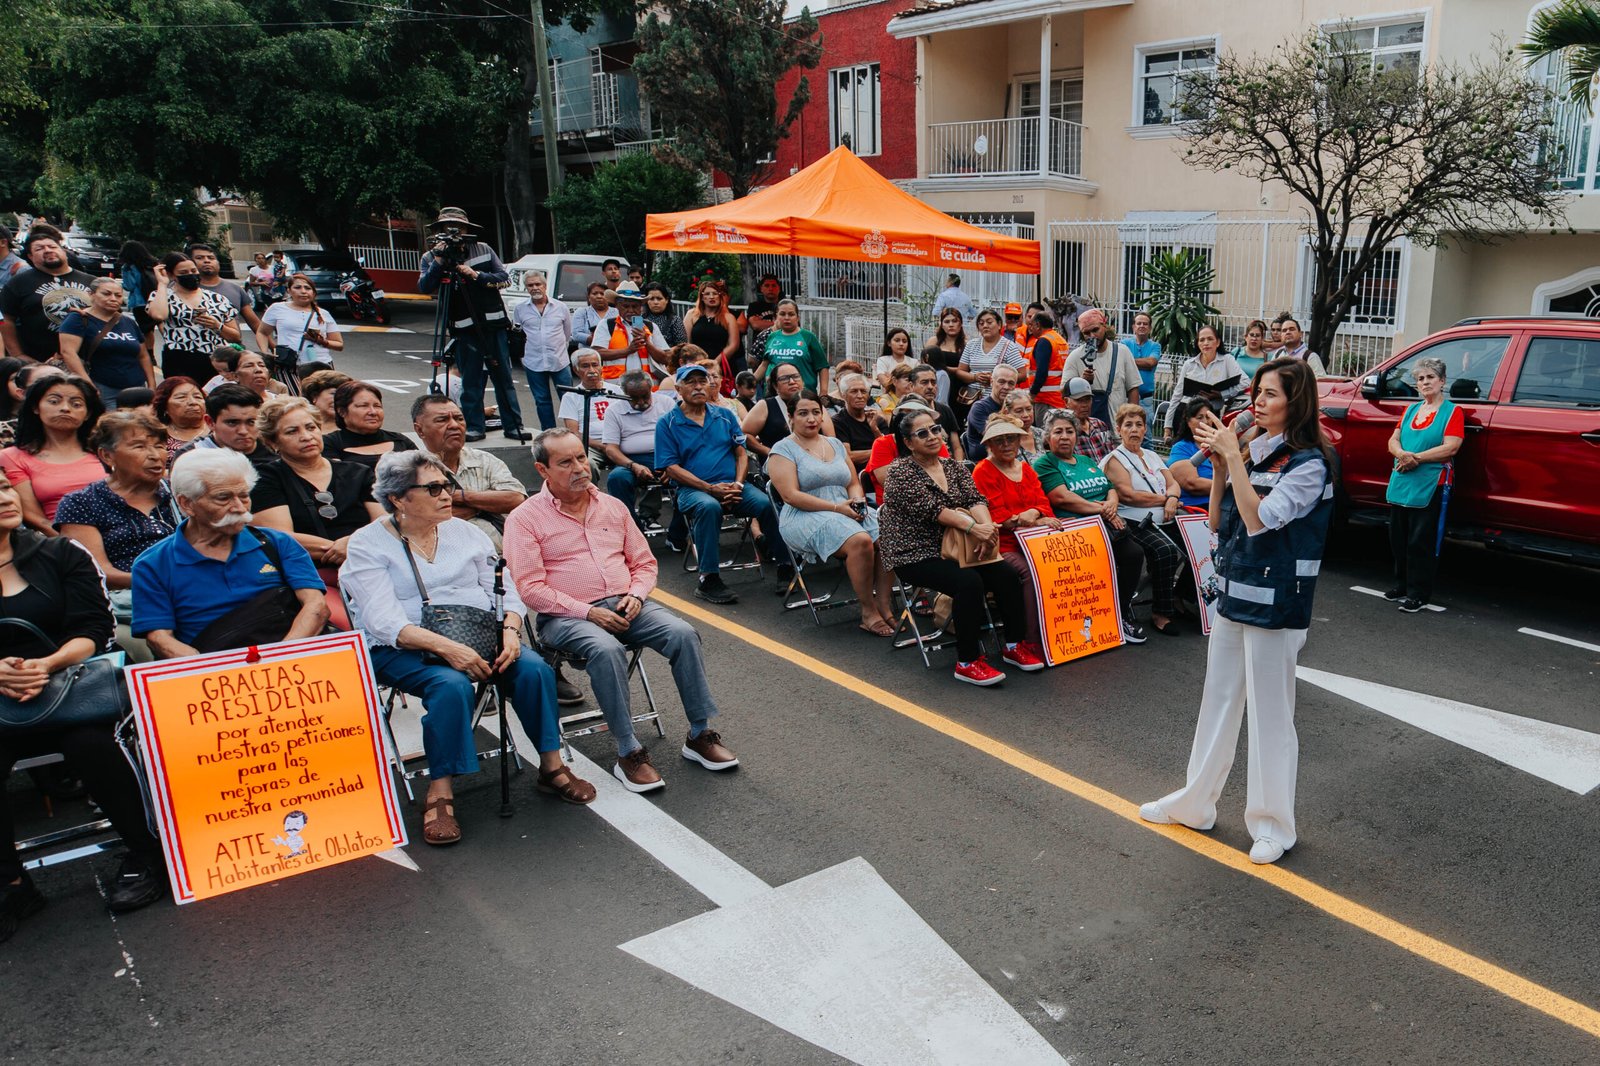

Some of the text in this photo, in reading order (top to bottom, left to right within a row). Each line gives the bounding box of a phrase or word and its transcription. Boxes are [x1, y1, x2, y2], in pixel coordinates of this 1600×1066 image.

[891, 247, 928, 257] Guadalajara
[940, 247, 986, 264] te cuida
[769, 348, 804, 357] JALISCO
[1069, 476, 1109, 492] JALISCO
[1044, 532, 1085, 551] GRACIAS
[1041, 544, 1097, 564] PRESIDENTA
[1054, 571, 1096, 587] remodelación
[1057, 562, 1081, 578] por la
[1049, 580, 1107, 600] de esta importante
[1071, 594, 1099, 608] olvidada
[1053, 605, 1111, 628] por tanto tiempo
[1055, 630, 1073, 645] ATTE
[1058, 631, 1118, 657] Vecinos de Oblatos
[201, 663, 306, 701] GRACIAS
[187, 679, 341, 726] PRESIDENTA
[217, 708, 325, 752] por atender
[197, 724, 365, 766] nuestras peticiones
[238, 752, 308, 784] para las
[220, 767, 320, 803] mejoras de
[205, 774, 365, 824] nuestra comunidad
[214, 832, 271, 863] ATTE
[206, 851, 302, 889] Habitantes
[305, 843, 324, 865] de
[325, 831, 384, 858] Oblatos
